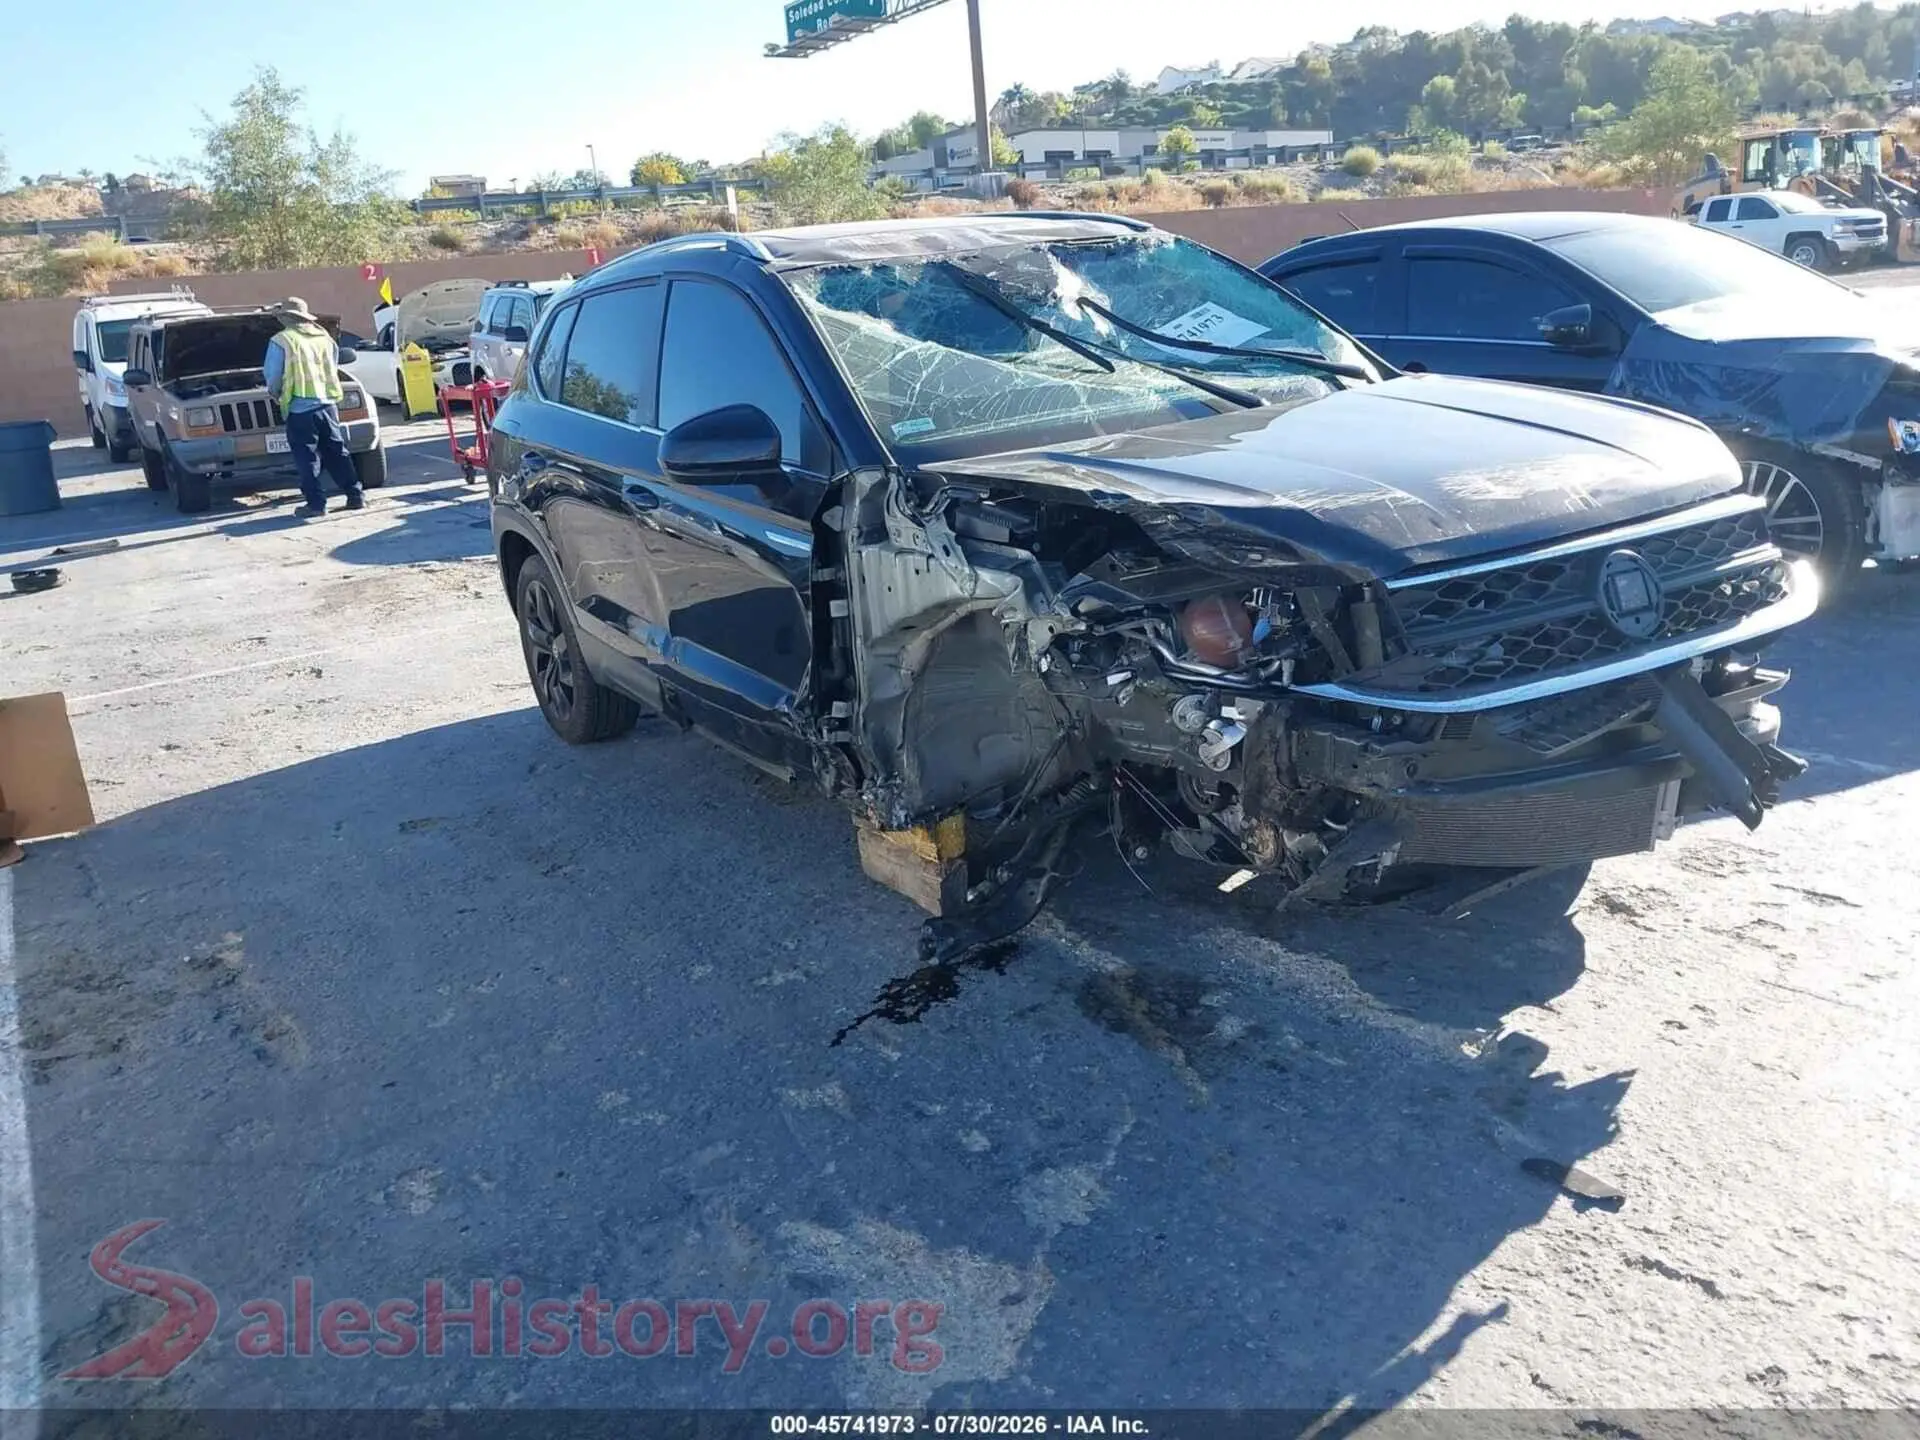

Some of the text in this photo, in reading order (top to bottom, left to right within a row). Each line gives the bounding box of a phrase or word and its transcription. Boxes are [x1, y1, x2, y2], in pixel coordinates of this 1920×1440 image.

[788, 0, 824, 23] Soledad
[592, 250, 600, 265] 1
[365, 264, 377, 281] 2
